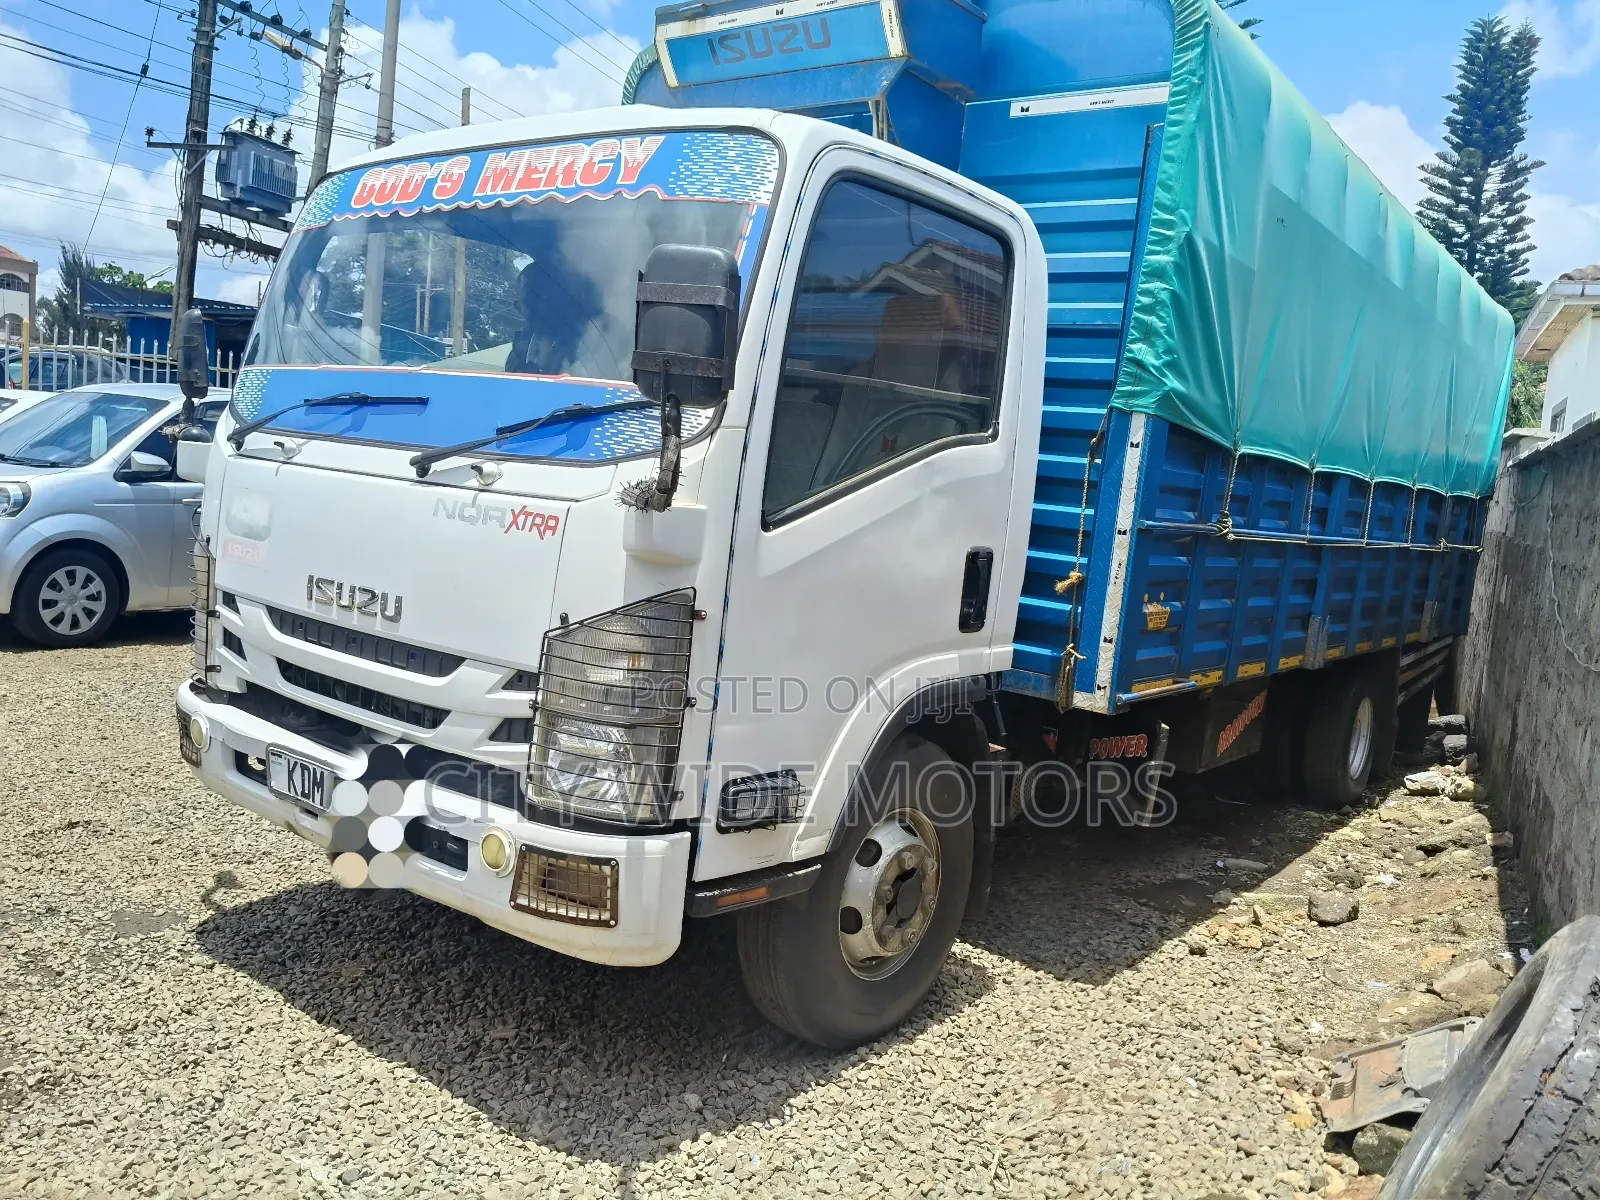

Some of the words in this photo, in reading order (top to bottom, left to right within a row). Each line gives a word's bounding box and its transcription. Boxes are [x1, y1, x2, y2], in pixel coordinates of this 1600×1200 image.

[706, 17, 832, 66] ISUZU
[350, 155, 471, 209] GOD'S
[474, 134, 667, 197] MERCY
[503, 504, 560, 541] XTRA
[306, 573, 403, 624] ISUZU
[1089, 732, 1149, 760] POWER
[287, 756, 326, 807] KDM
